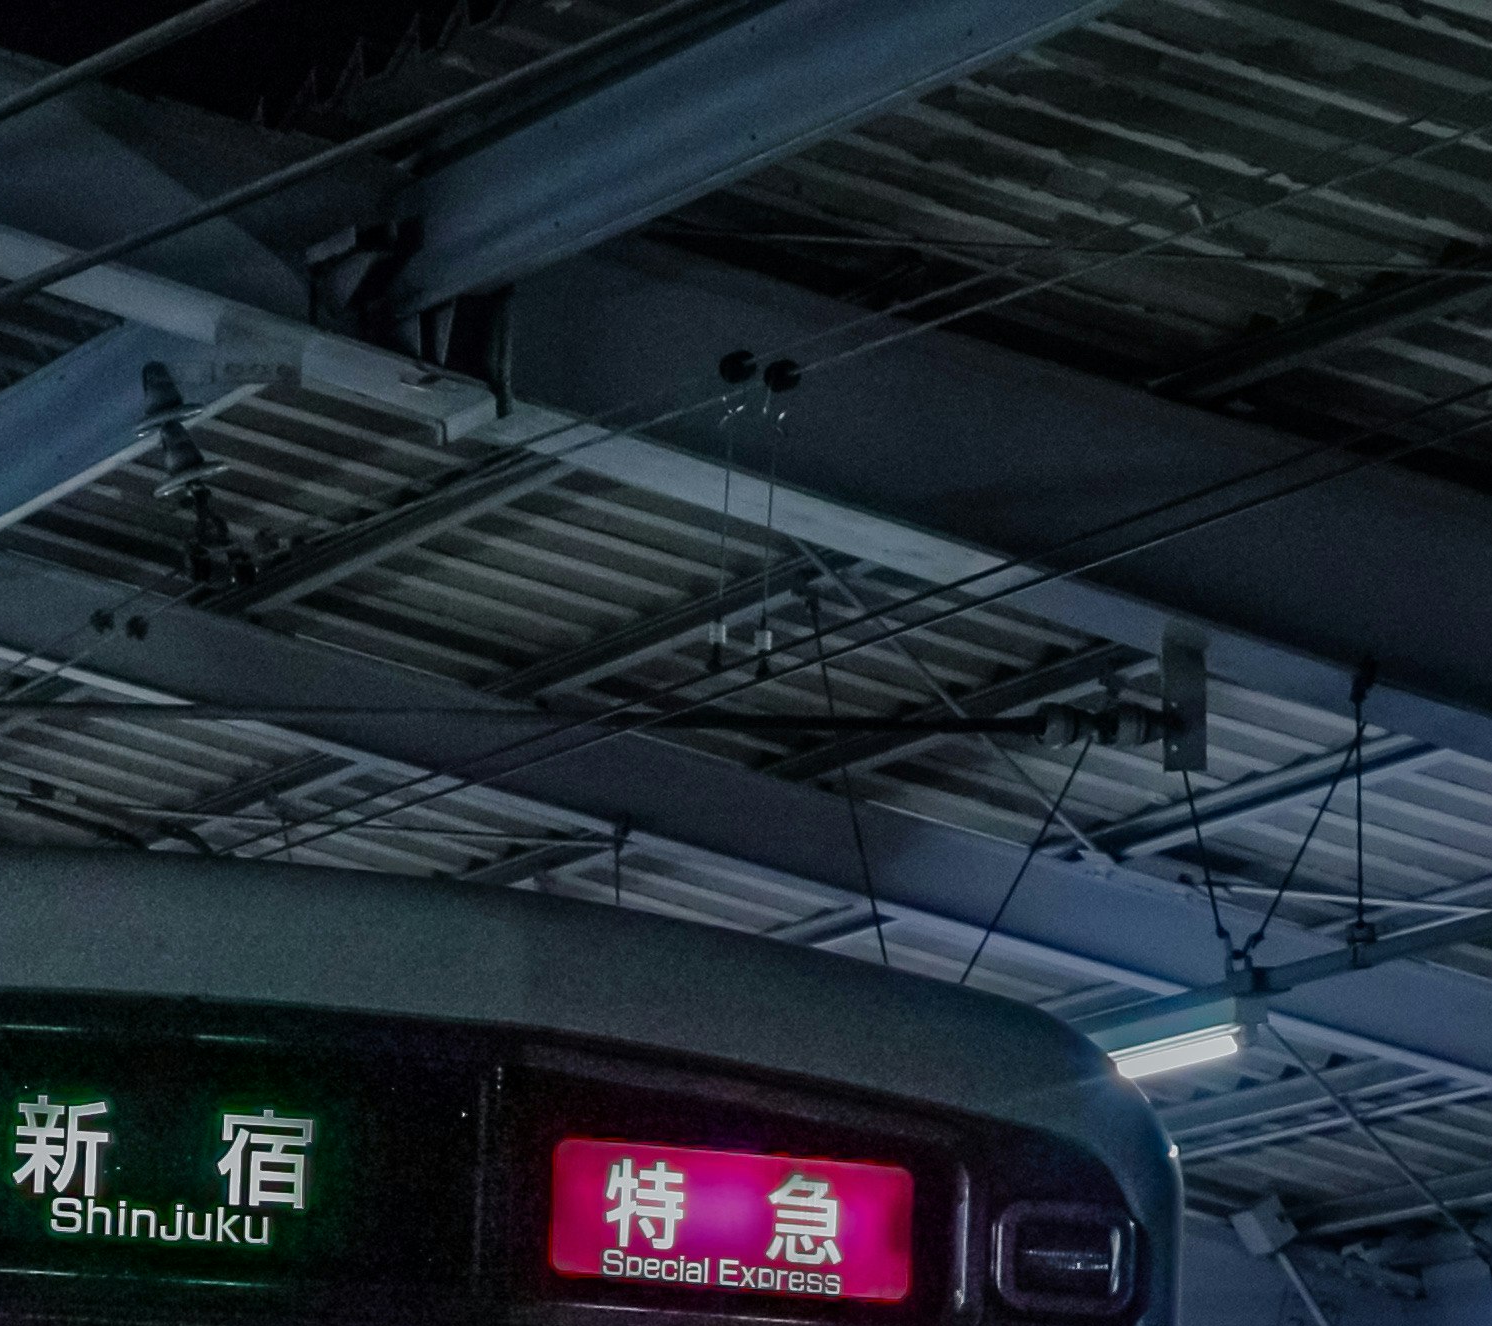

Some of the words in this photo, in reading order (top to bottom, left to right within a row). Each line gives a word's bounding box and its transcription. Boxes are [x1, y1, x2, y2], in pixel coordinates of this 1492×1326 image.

[12, 1095, 314, 1209] 新宿
[49, 1197, 270, 1244] Shinjuku
[605, 1158, 842, 1264] 特急
[602, 1249, 709, 1284] Special
[718, 1258, 841, 1295] Express
